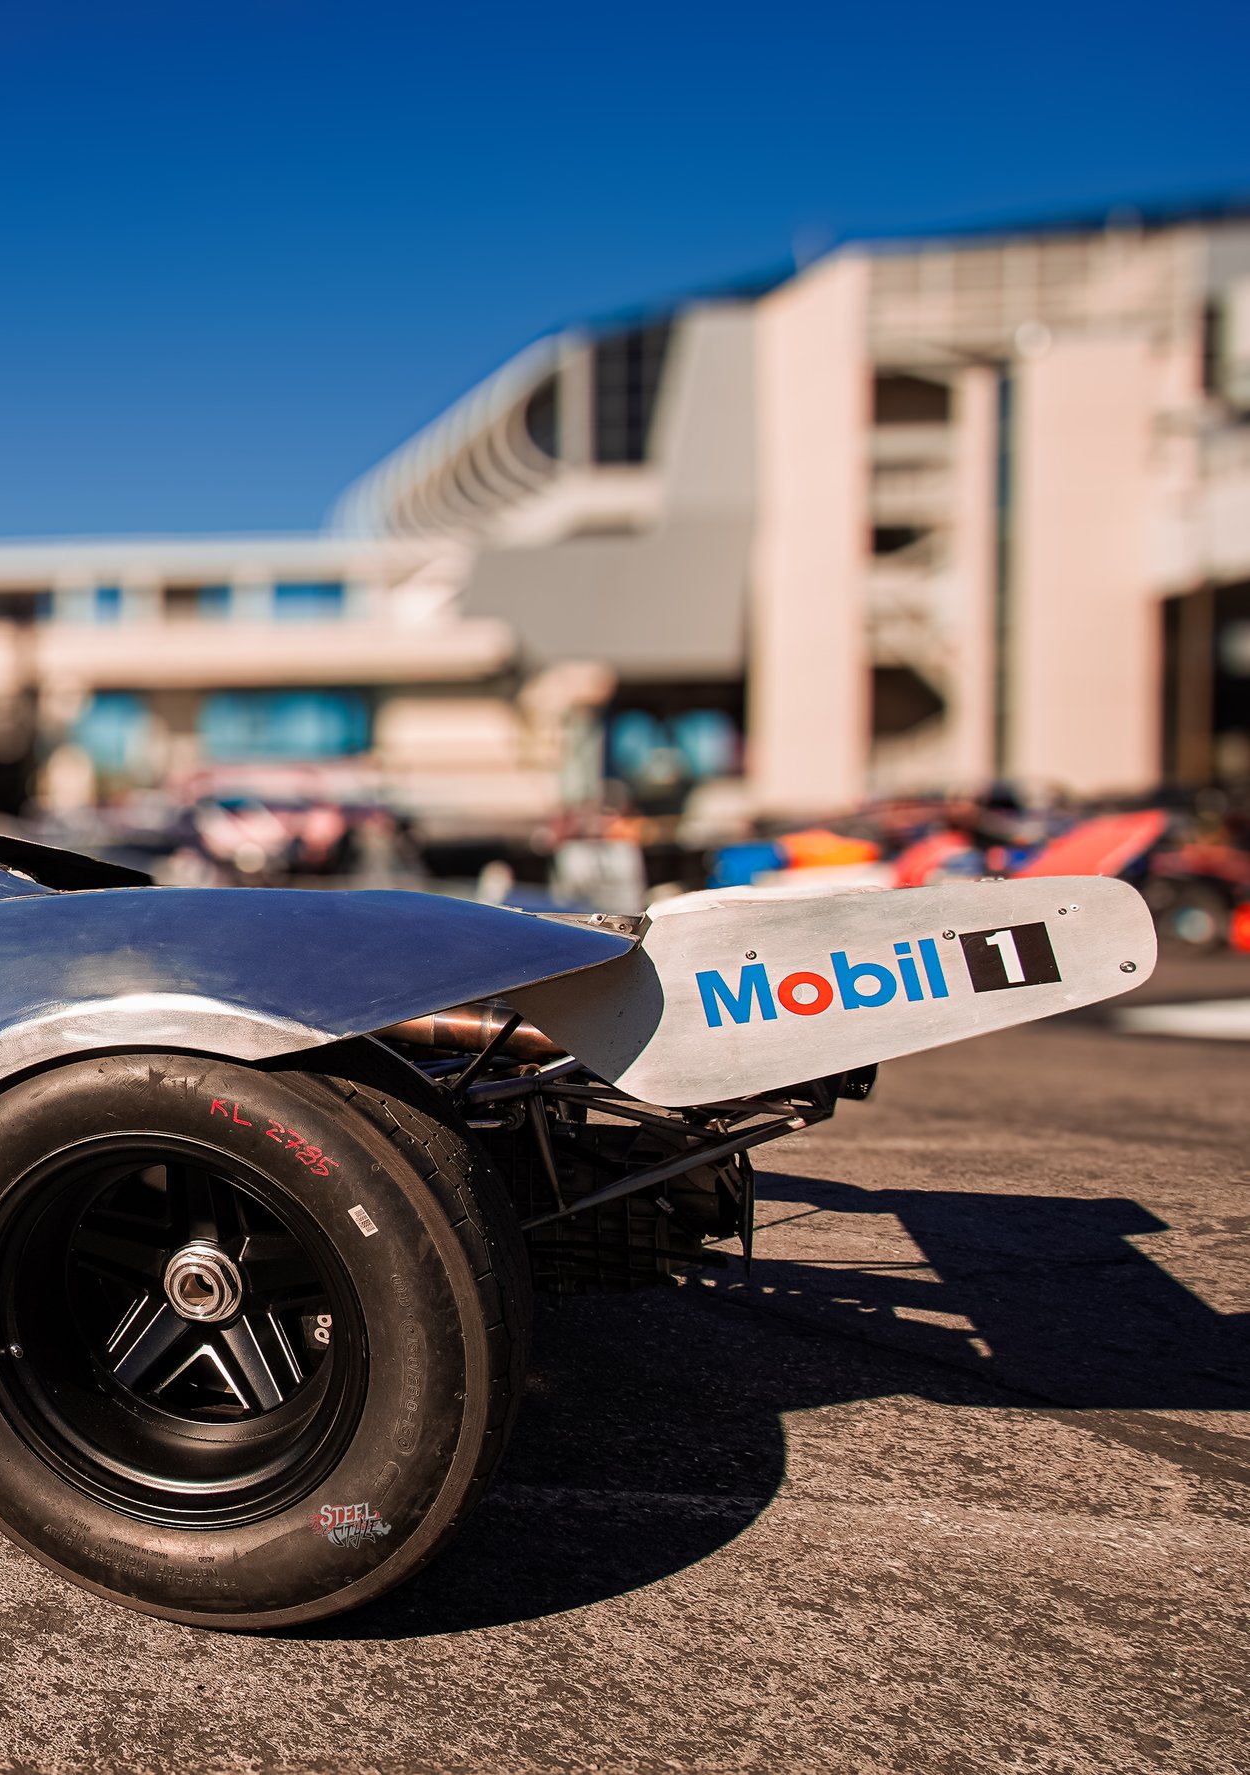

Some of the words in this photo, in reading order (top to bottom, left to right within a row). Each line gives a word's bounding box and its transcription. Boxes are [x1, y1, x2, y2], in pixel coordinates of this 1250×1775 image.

[695, 938, 950, 1028] Mobil
[984, 929, 1026, 984] 1
[265, 1119, 340, 1177] 2785
